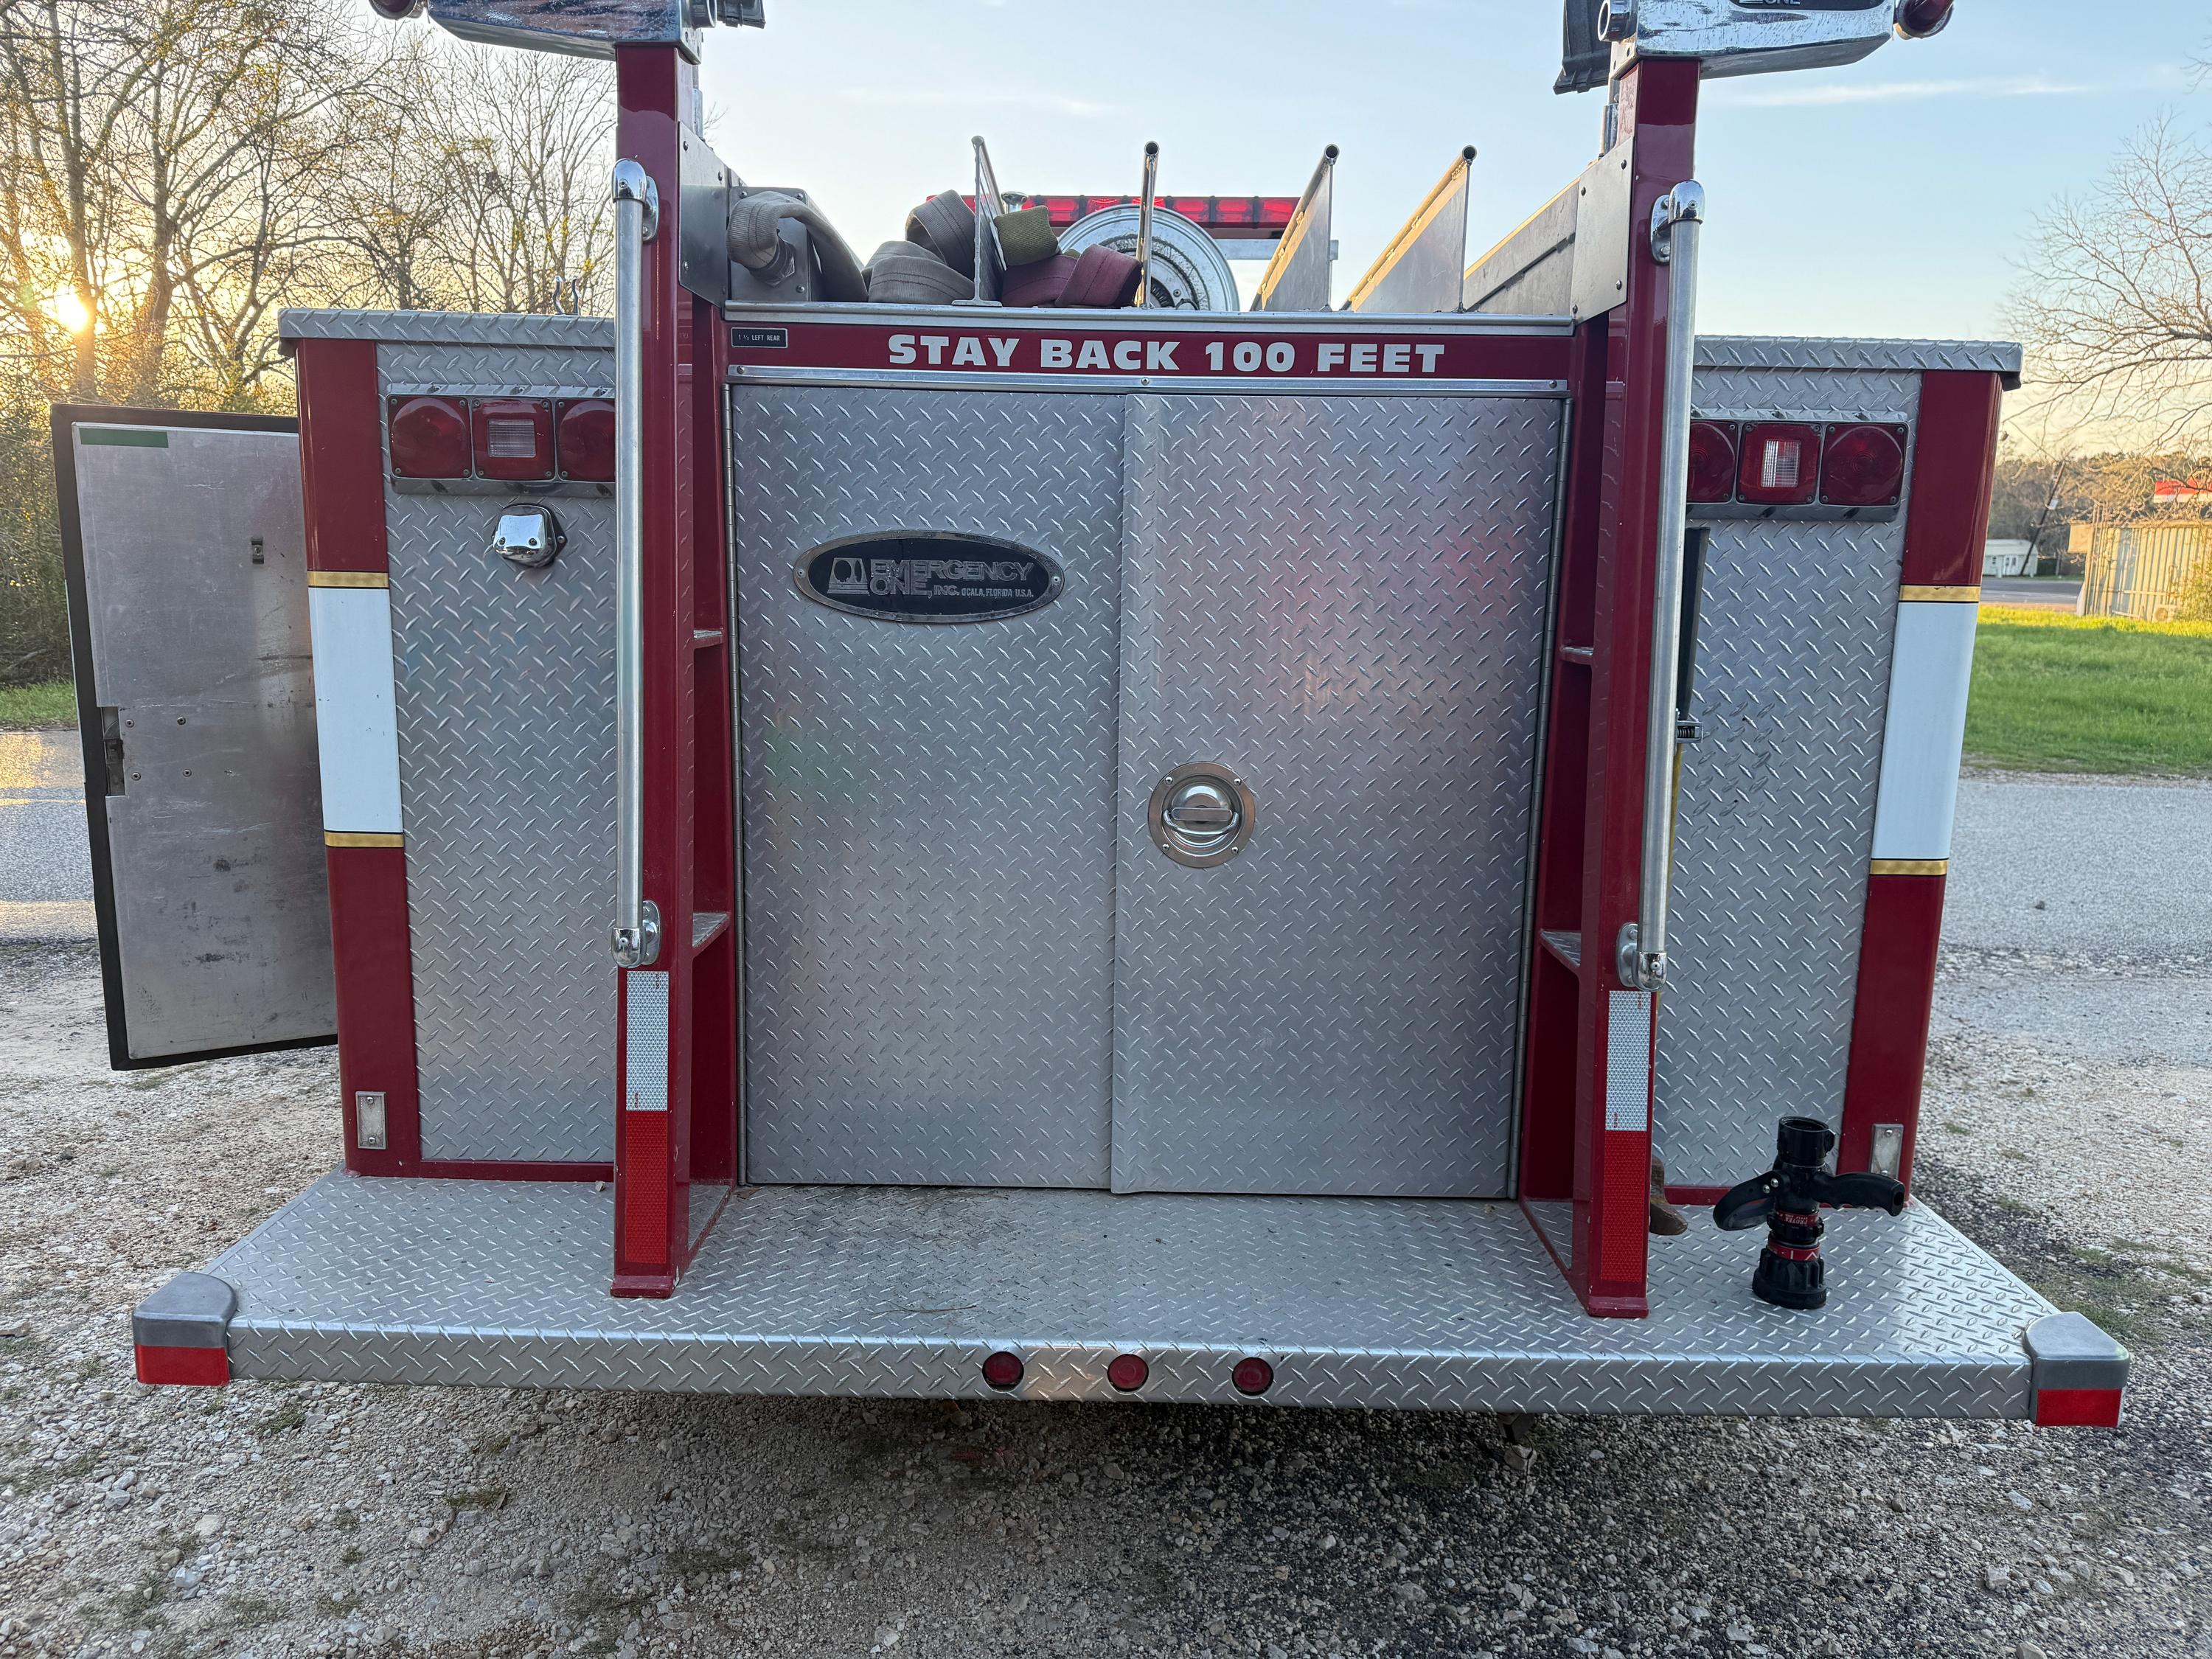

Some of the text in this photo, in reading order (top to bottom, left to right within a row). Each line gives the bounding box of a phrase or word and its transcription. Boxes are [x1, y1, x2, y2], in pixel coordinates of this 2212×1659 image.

[888, 334, 1445, 373] STAY BACK 100 FEET
[870, 559, 1034, 581] EMERGENCY
[933, 585, 959, 596] INC.
[961, 588, 985, 598] OCALA,
[986, 588, 1012, 598] FLORIDA
[1015, 589, 1034, 597] U.S.A.
